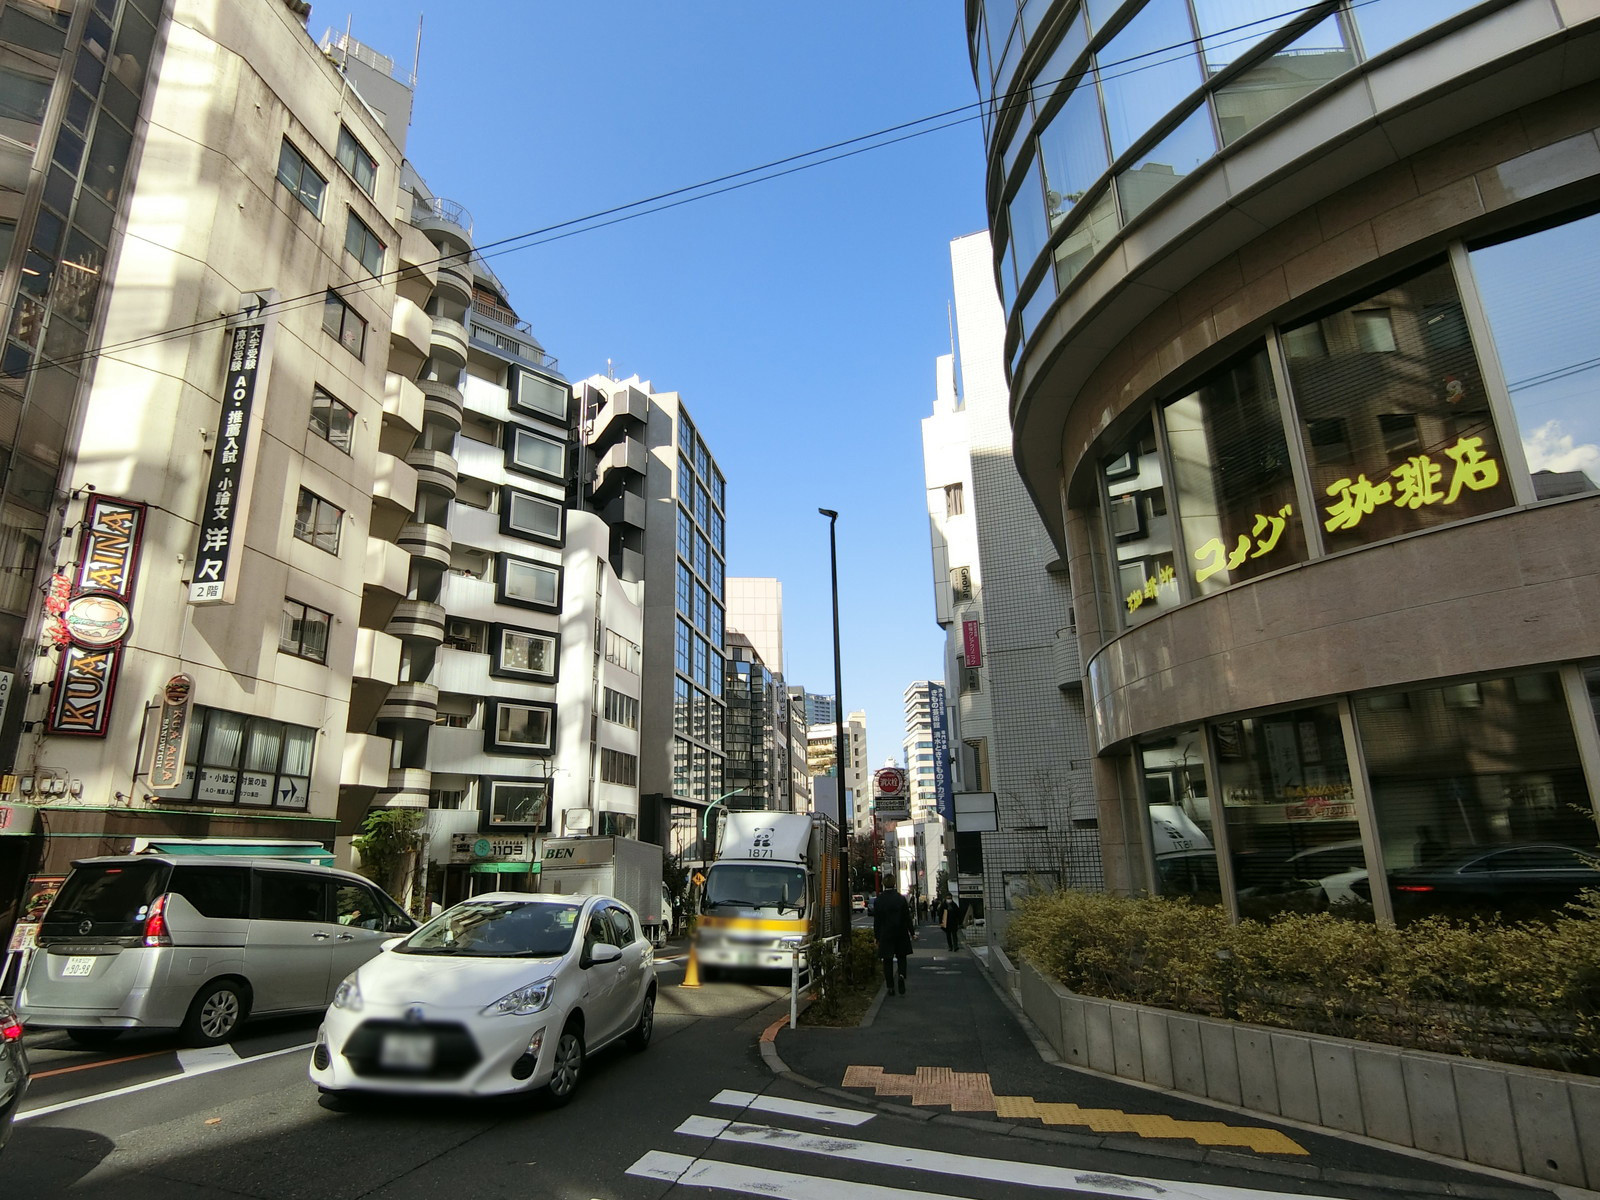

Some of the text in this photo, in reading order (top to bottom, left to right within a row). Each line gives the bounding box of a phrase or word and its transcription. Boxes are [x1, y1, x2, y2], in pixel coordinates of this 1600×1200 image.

[230, 329, 248, 372] 高校受験
[244, 329, 262, 370] 大学受験
[1194, 504, 1292, 583] コメダ
[1324, 436, 1499, 533] 珈琲店
[198, 526, 229, 581] 洋々
[196, 585, 219, 597] 2階
[62, 512, 134, 726] KUA AINA
[155, 718, 170, 768] SANDWICH
[880, 777, 898, 787] 消火栓
[493, 845, 523, 855] 1103
[545, 848, 575, 859] BEN
[748, 848, 773, 858] 1871
